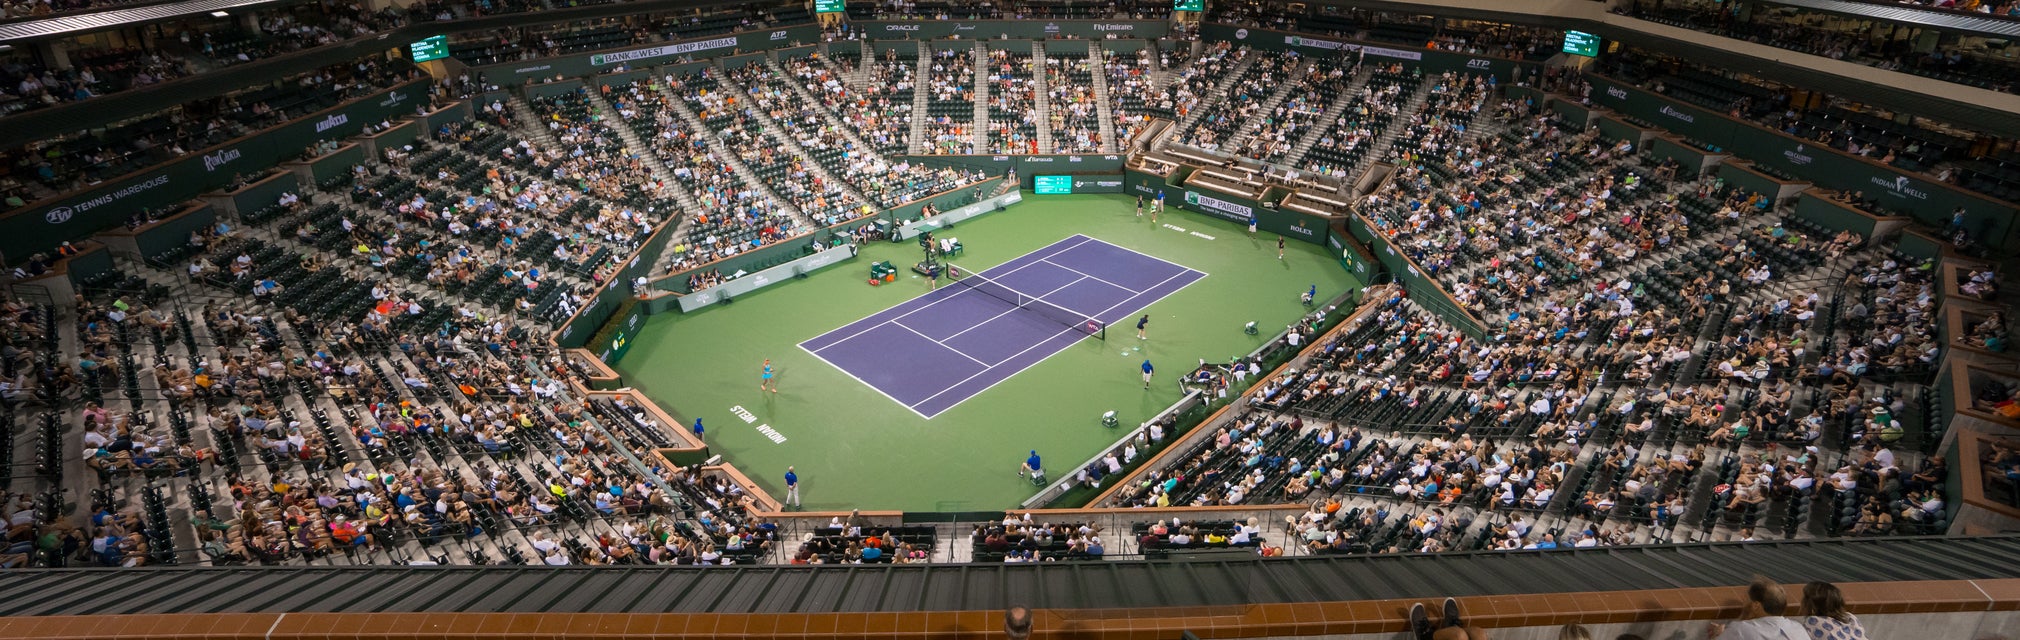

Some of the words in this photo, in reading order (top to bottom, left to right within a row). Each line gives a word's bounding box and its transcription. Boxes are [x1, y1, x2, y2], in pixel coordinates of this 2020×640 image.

[676, 44, 696, 52] BNP
[697, 38, 735, 49] PARIBAS
[605, 52, 630, 62] BANK
[639, 48, 664, 57] WEST
[1467, 58, 1490, 67] ATP
[1607, 86, 1627, 100] Hertz
[316, 113, 348, 133] LAVAZZA
[1668, 108, 1694, 123] Barracuda
[73, 194, 113, 213] TENNIS
[113, 174, 169, 200] WAREHOUSE
[1136, 184, 1153, 194] ROLEX
[1871, 176, 1896, 189] INDIAN
[1904, 187, 1927, 200] WELLS
[1200, 197, 1215, 206] BNP
[1218, 201, 1248, 215] PARIBAS
[1290, 225, 1312, 236] ROLEX
[583, 296, 599, 317] ORACLE
[730, 405, 757, 424] WELLS
[756, 423, 787, 444] INDIAN
